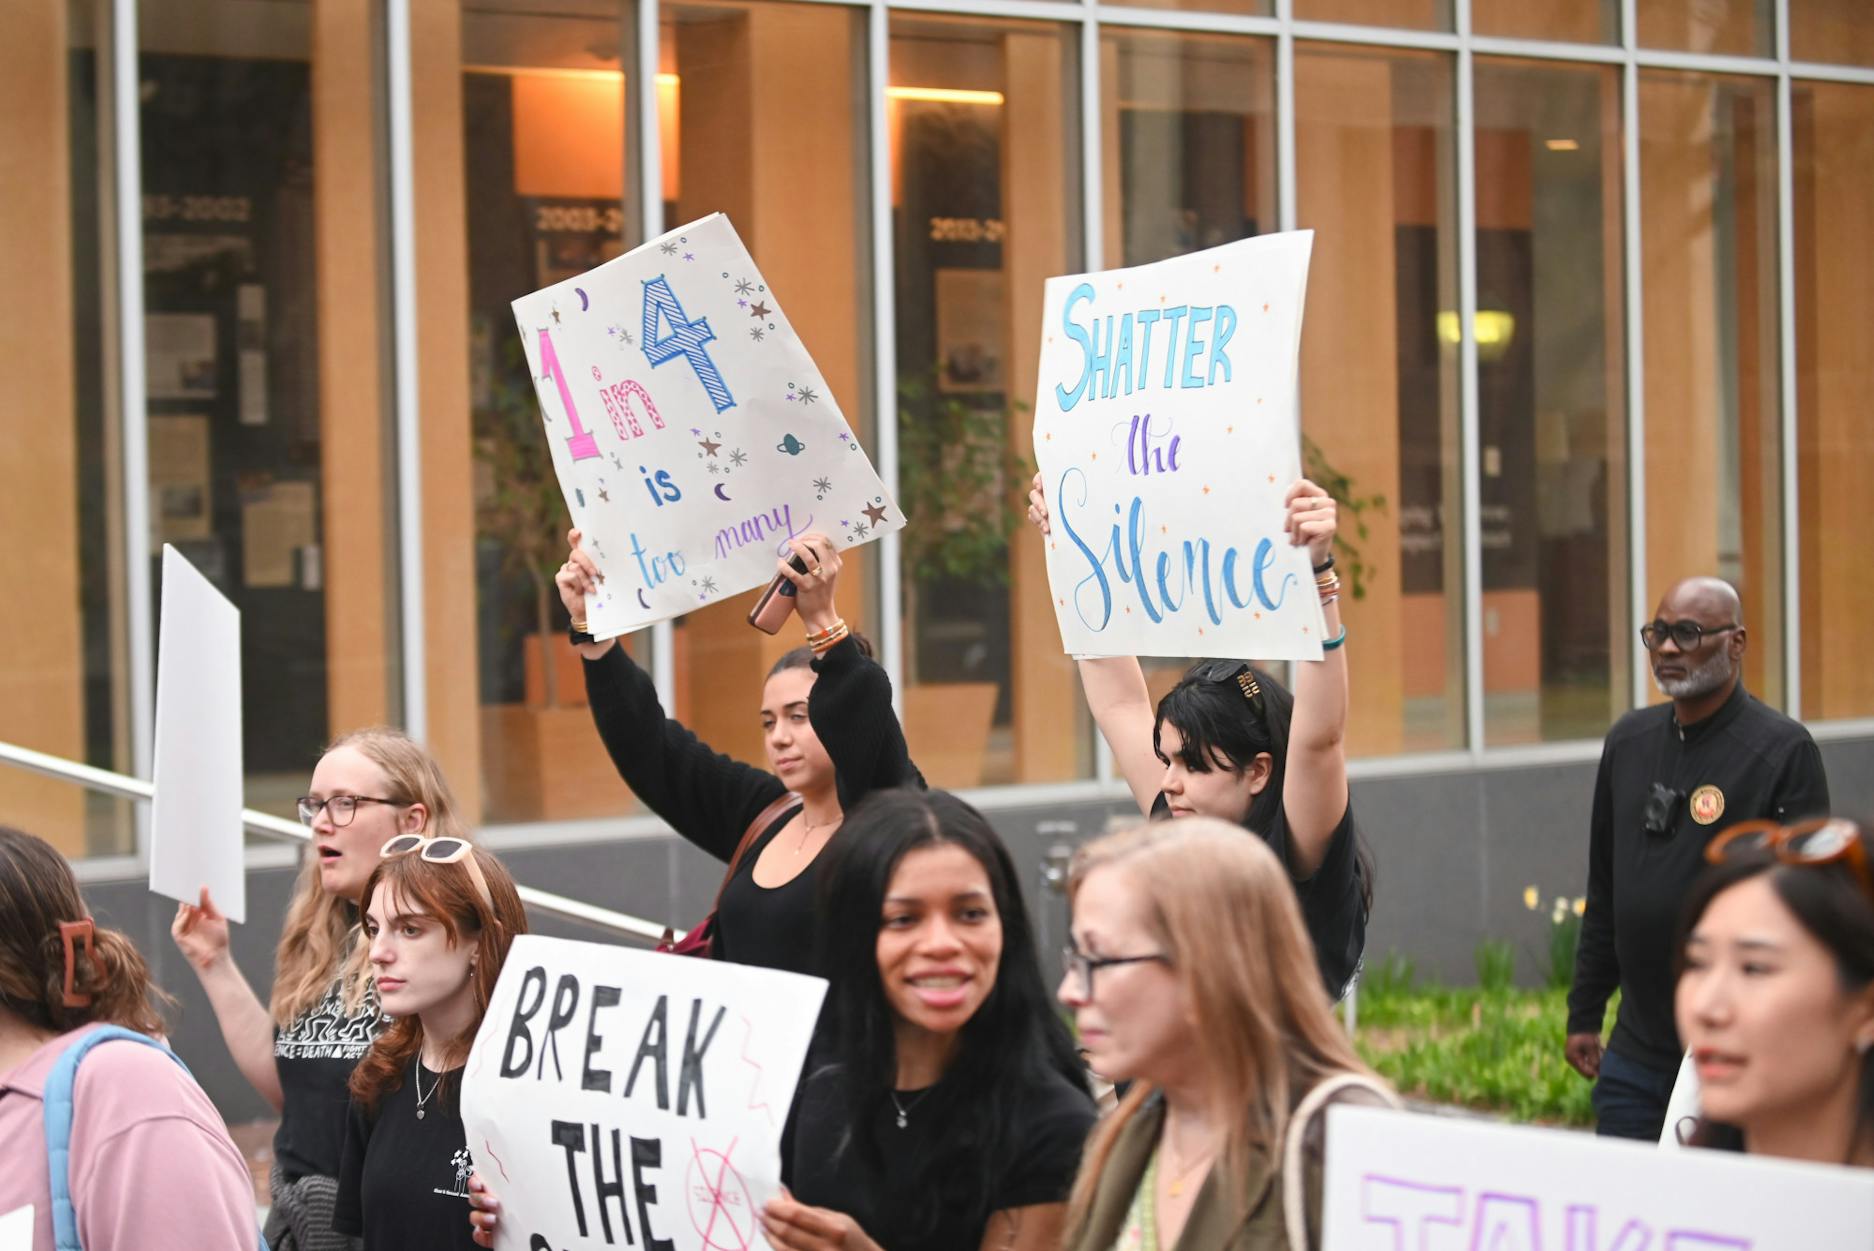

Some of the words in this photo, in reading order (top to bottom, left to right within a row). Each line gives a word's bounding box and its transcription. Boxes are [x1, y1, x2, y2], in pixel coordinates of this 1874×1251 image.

[537, 328, 602, 461] 1
[591, 366, 665, 441] in
[641, 274, 737, 414] 4
[1055, 283, 1238, 412] SHATTER
[639, 466, 681, 506] is
[1111, 413, 1182, 476] the
[630, 533, 686, 589] too
[714, 504, 813, 557] many
[1058, 467, 1298, 632] Silence
[302, 1044, 334, 1058] DEATH
[500, 966, 727, 1119] BREAK
[551, 1119, 676, 1251] THE
